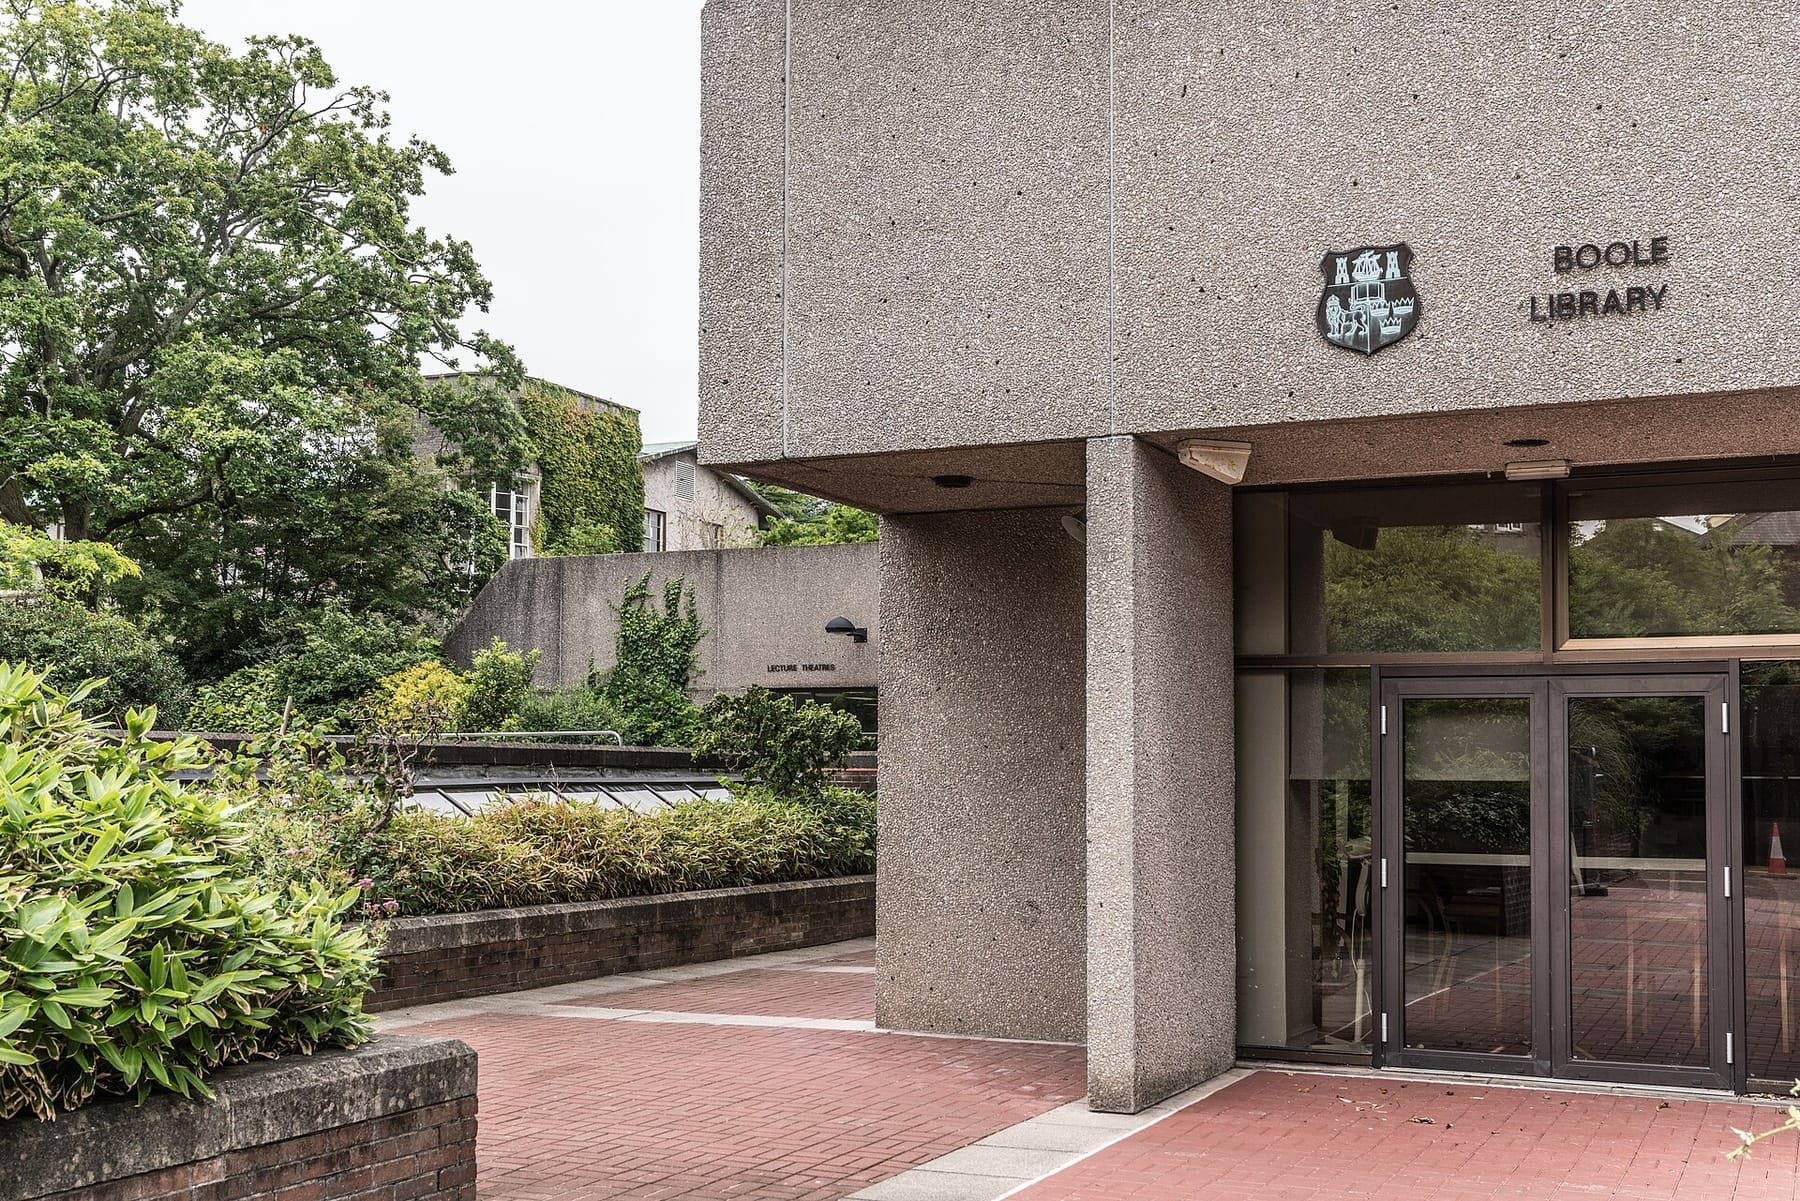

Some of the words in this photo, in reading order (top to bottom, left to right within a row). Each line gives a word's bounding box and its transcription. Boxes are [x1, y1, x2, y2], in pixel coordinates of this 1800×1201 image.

[1554, 236, 1668, 272] BOOLE
[1530, 284, 1668, 321] LIBRARY
[767, 664, 798, 673] LECTURE
[802, 663, 836, 672] THEATRES
